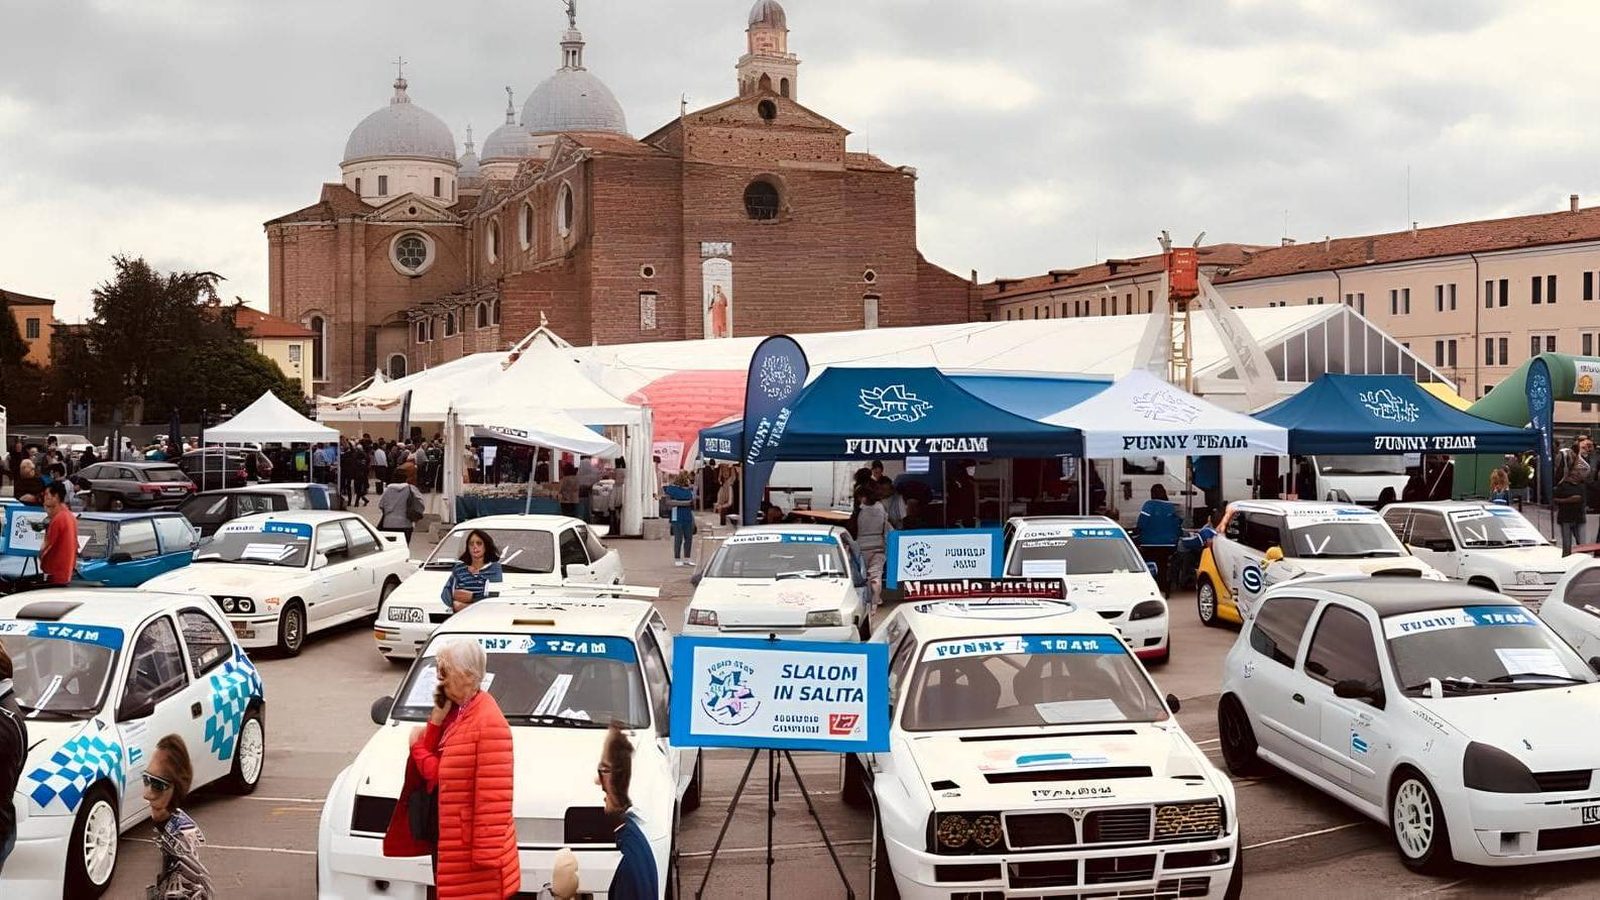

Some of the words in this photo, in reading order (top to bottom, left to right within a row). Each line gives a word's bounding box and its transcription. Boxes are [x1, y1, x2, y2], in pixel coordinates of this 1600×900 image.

[845, 438, 920, 454] FUNNY
[925, 437, 988, 453] TEAM
[781, 664, 858, 681] SLALOM
[774, 685, 794, 700] IN
[799, 686, 864, 703] SALITA
